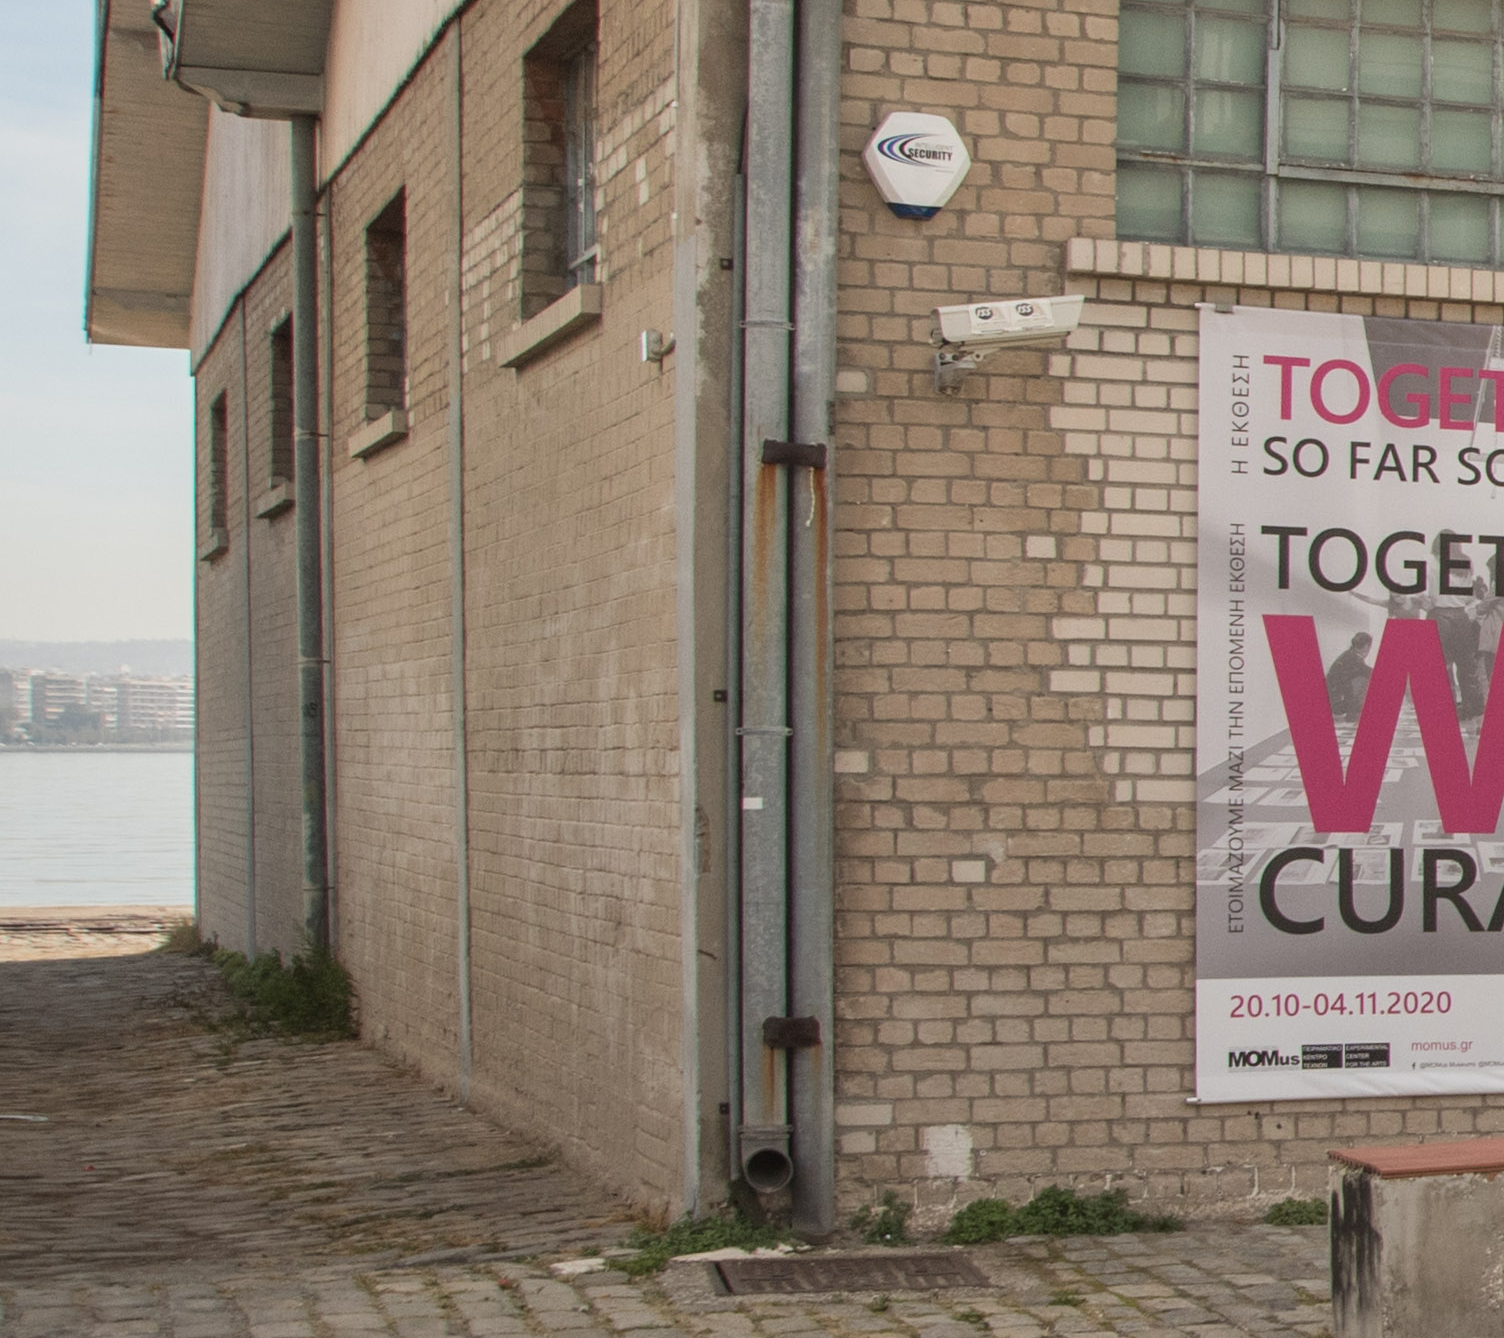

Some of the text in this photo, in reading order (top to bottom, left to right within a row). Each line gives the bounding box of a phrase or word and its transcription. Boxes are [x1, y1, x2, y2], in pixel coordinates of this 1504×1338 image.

[909, 148, 953, 161] SECURITY
[1231, 354, 1250, 447] ΕΚΘΕΣΗ
[1262, 436, 1330, 478] SO
[1350, 441, 1441, 484] FAR
[1228, 523, 1246, 934] ΕΤΟΙΜΑΖΟΥΜΕ ΜΑΖΙ ΤΗΝ ΕΠΟΜΕΝΗ ΕΚΘΕΣΗ
[1230, 991, 1452, 1018] 20.10-04.11.2020
[1228, 1050, 1300, 1068] MOMus
[1411, 1039, 1474, 1052] momus.gr
